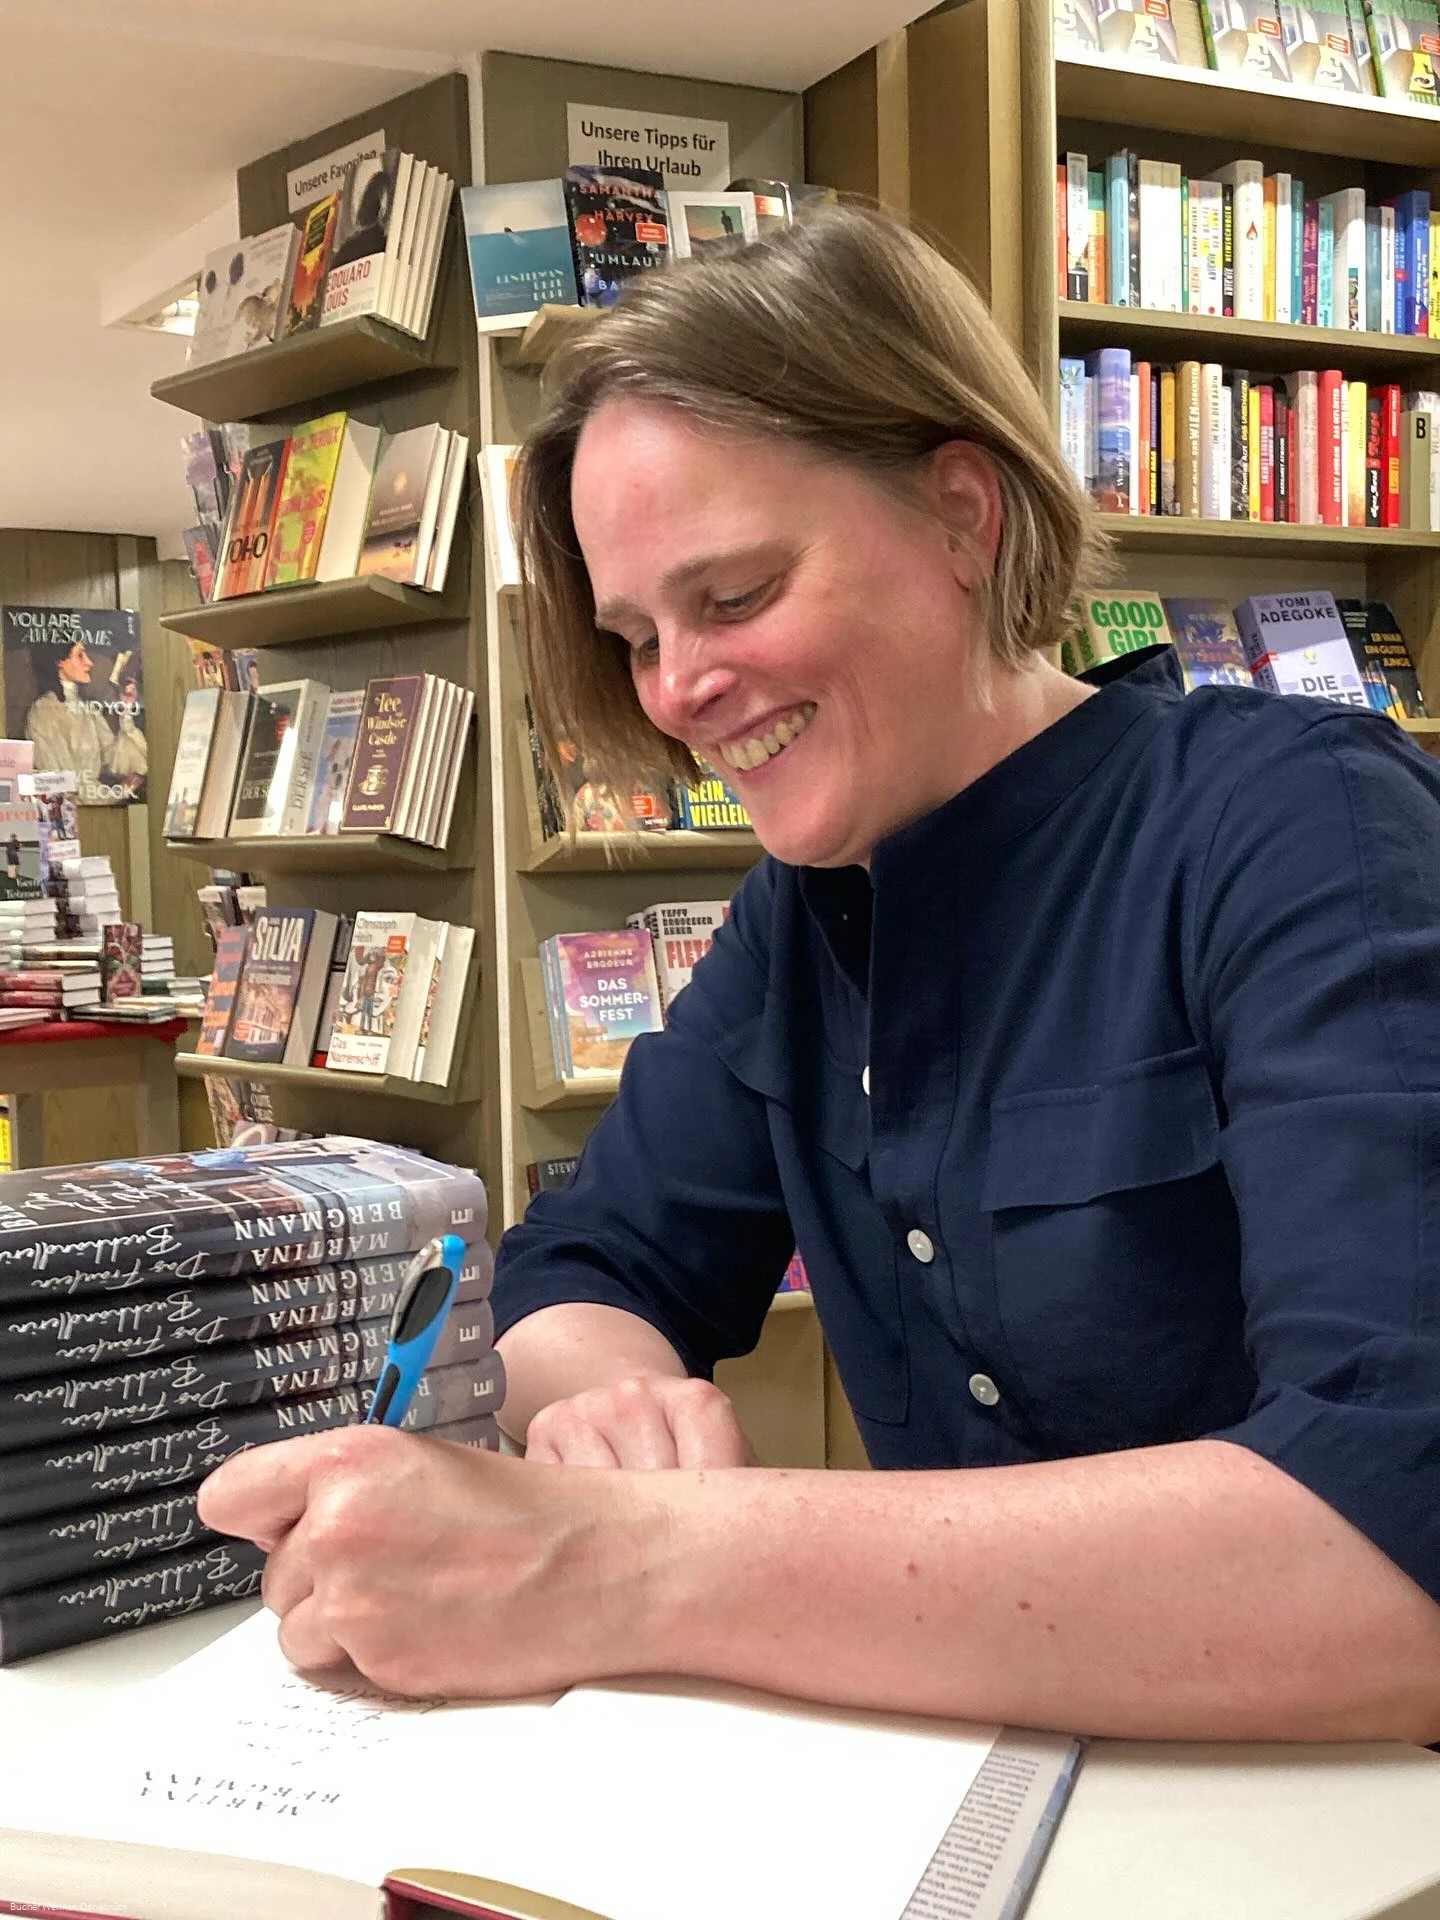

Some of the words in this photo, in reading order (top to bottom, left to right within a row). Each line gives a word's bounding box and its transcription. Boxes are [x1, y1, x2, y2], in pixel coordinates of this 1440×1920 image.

[581, 120, 640, 143] Unsere
[644, 128, 688, 150] Tipps
[693, 133, 716, 151] für
[598, 150, 642, 169] Ihren
[646, 155, 701, 177] Urlaub
[295, 172, 328, 196] Unsere
[579, 184, 660, 199] SAMANTHA
[594, 210, 654, 223] HARVEY
[595, 253, 662, 268] UMLAUF
[1190, 406, 1199, 440] WIEN
[1416, 418, 1426, 439] B
[1091, 601, 1164, 628] GOOD
[1260, 607, 1336, 624] ADEGOKE
[1276, 597, 1310, 608] YOMI
[8, 611, 46, 627] YOU
[48, 613, 82, 629] ARE
[22, 629, 113, 646] AWESOME
[1301, 675, 1338, 692] DIE
[104, 700, 140, 715] YOU
[375, 692, 402, 713] Tee
[367, 716, 407, 730] Windsor
[368, 729, 397, 746] Castle
[87, 784, 138, 800] BOOK
[252, 916, 304, 962] SILVA
[598, 978, 628, 992] DAS
[579, 992, 649, 1008] SOMMER-
[599, 1008, 634, 1022] FEST
[233, 1200, 404, 1241] BERGMANN
[0, 1223, 182, 1270] Buchhändleri
[251, 1231, 390, 1267] MARTINA
[31, 1258, 145, 1294] Fräulein
[150, 1251, 211, 1280] Das
[8, 1290, 201, 1340] Buchhändlerin
[268, 1291, 396, 1330] MARTINA
[56, 1325, 165, 1362] Fräulein
[170, 1316, 229, 1344] Das
[254, 1324, 393, 1370] ERGMANN
[14, 1355, 206, 1408] Buchhändlerin
[271, 1356, 387, 1394] ARTINA
[173, 1381, 232, 1409] Das
[61, 1391, 169, 1430] Fräulein
[45, 1417, 230, 1473] Buchhändlerin
[91, 1453, 195, 1493] Fräulein
[49, 1494, 199, 1542] uchhändlerin
[93, 1520, 196, 1559] Fräulein
[58, 1546, 239, 1608] Buchhändlerin
[103, 1584, 205, 1626] Fräulein
